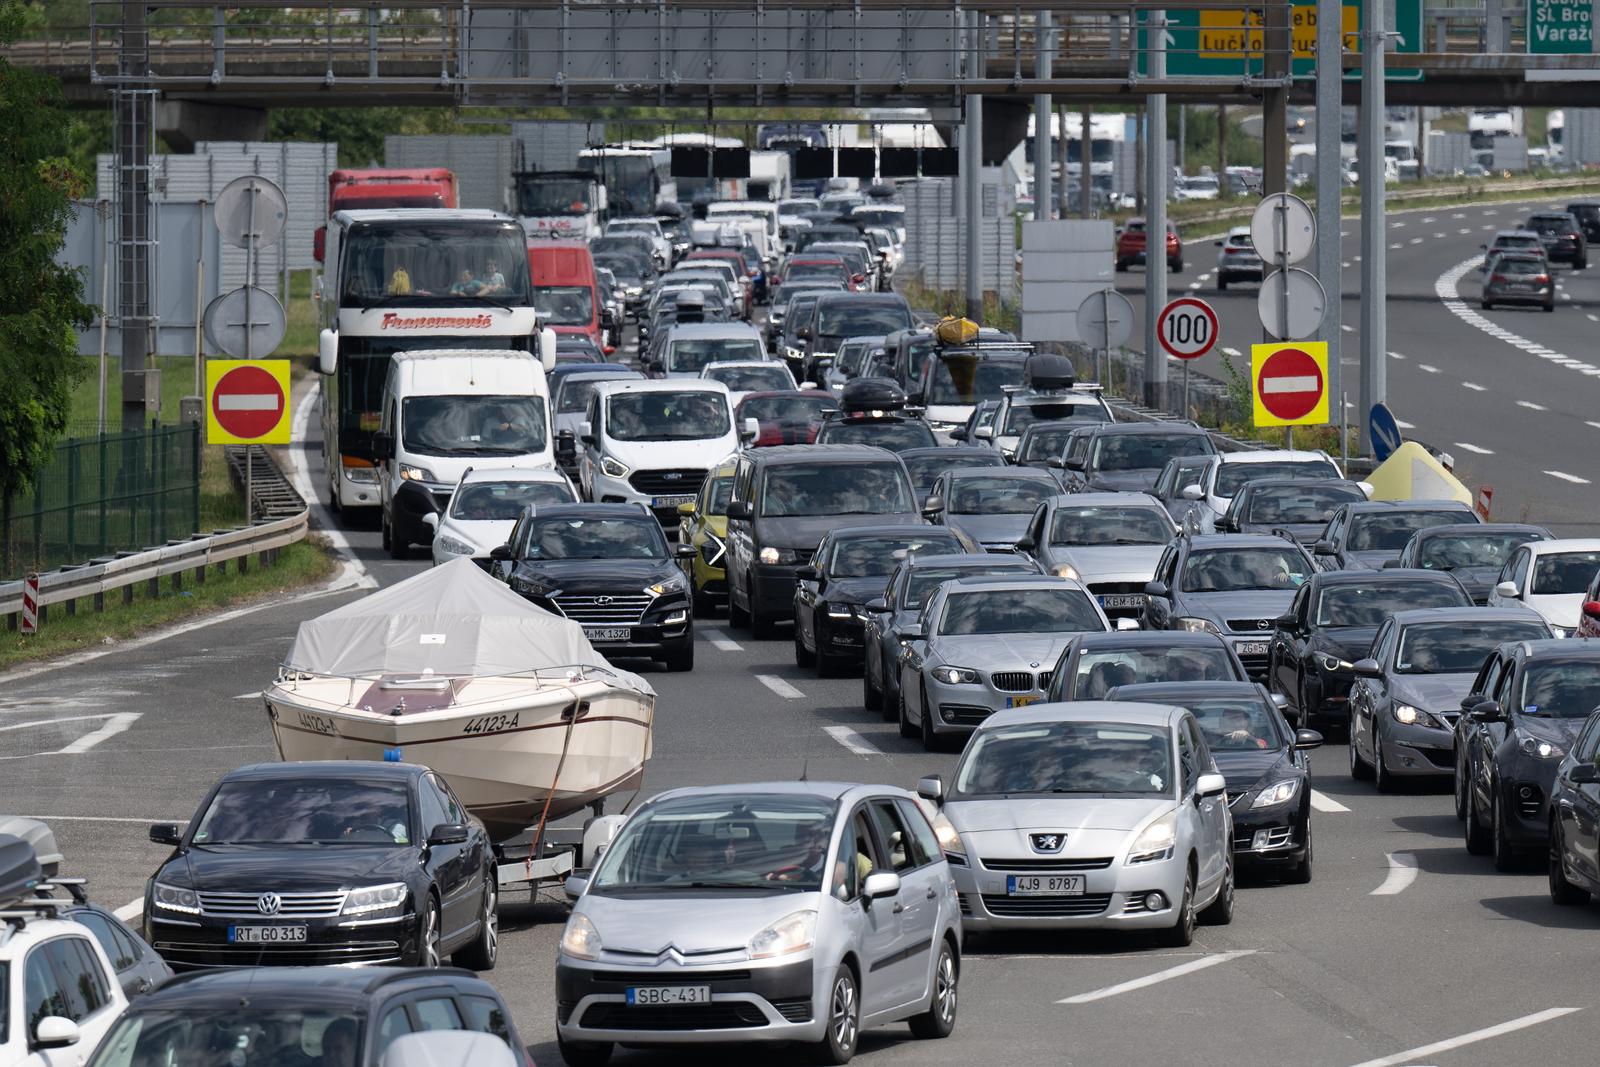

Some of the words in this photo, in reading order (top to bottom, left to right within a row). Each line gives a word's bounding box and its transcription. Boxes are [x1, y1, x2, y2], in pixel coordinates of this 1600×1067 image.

[1536, 7, 1556, 22] Sl.
[1562, 7, 1592, 22] Bro
[1168, 313, 1208, 344] 100
[608, 629, 630, 639] 1320
[463, 711, 520, 734] 44123-A
[1018, 878, 1040, 890] 4J9
[1049, 877, 1079, 890] 8787
[236, 927, 253, 941] RT
[261, 927, 278, 941] GO
[281, 927, 306, 941] 313
[638, 987, 705, 1004] SBC-431
